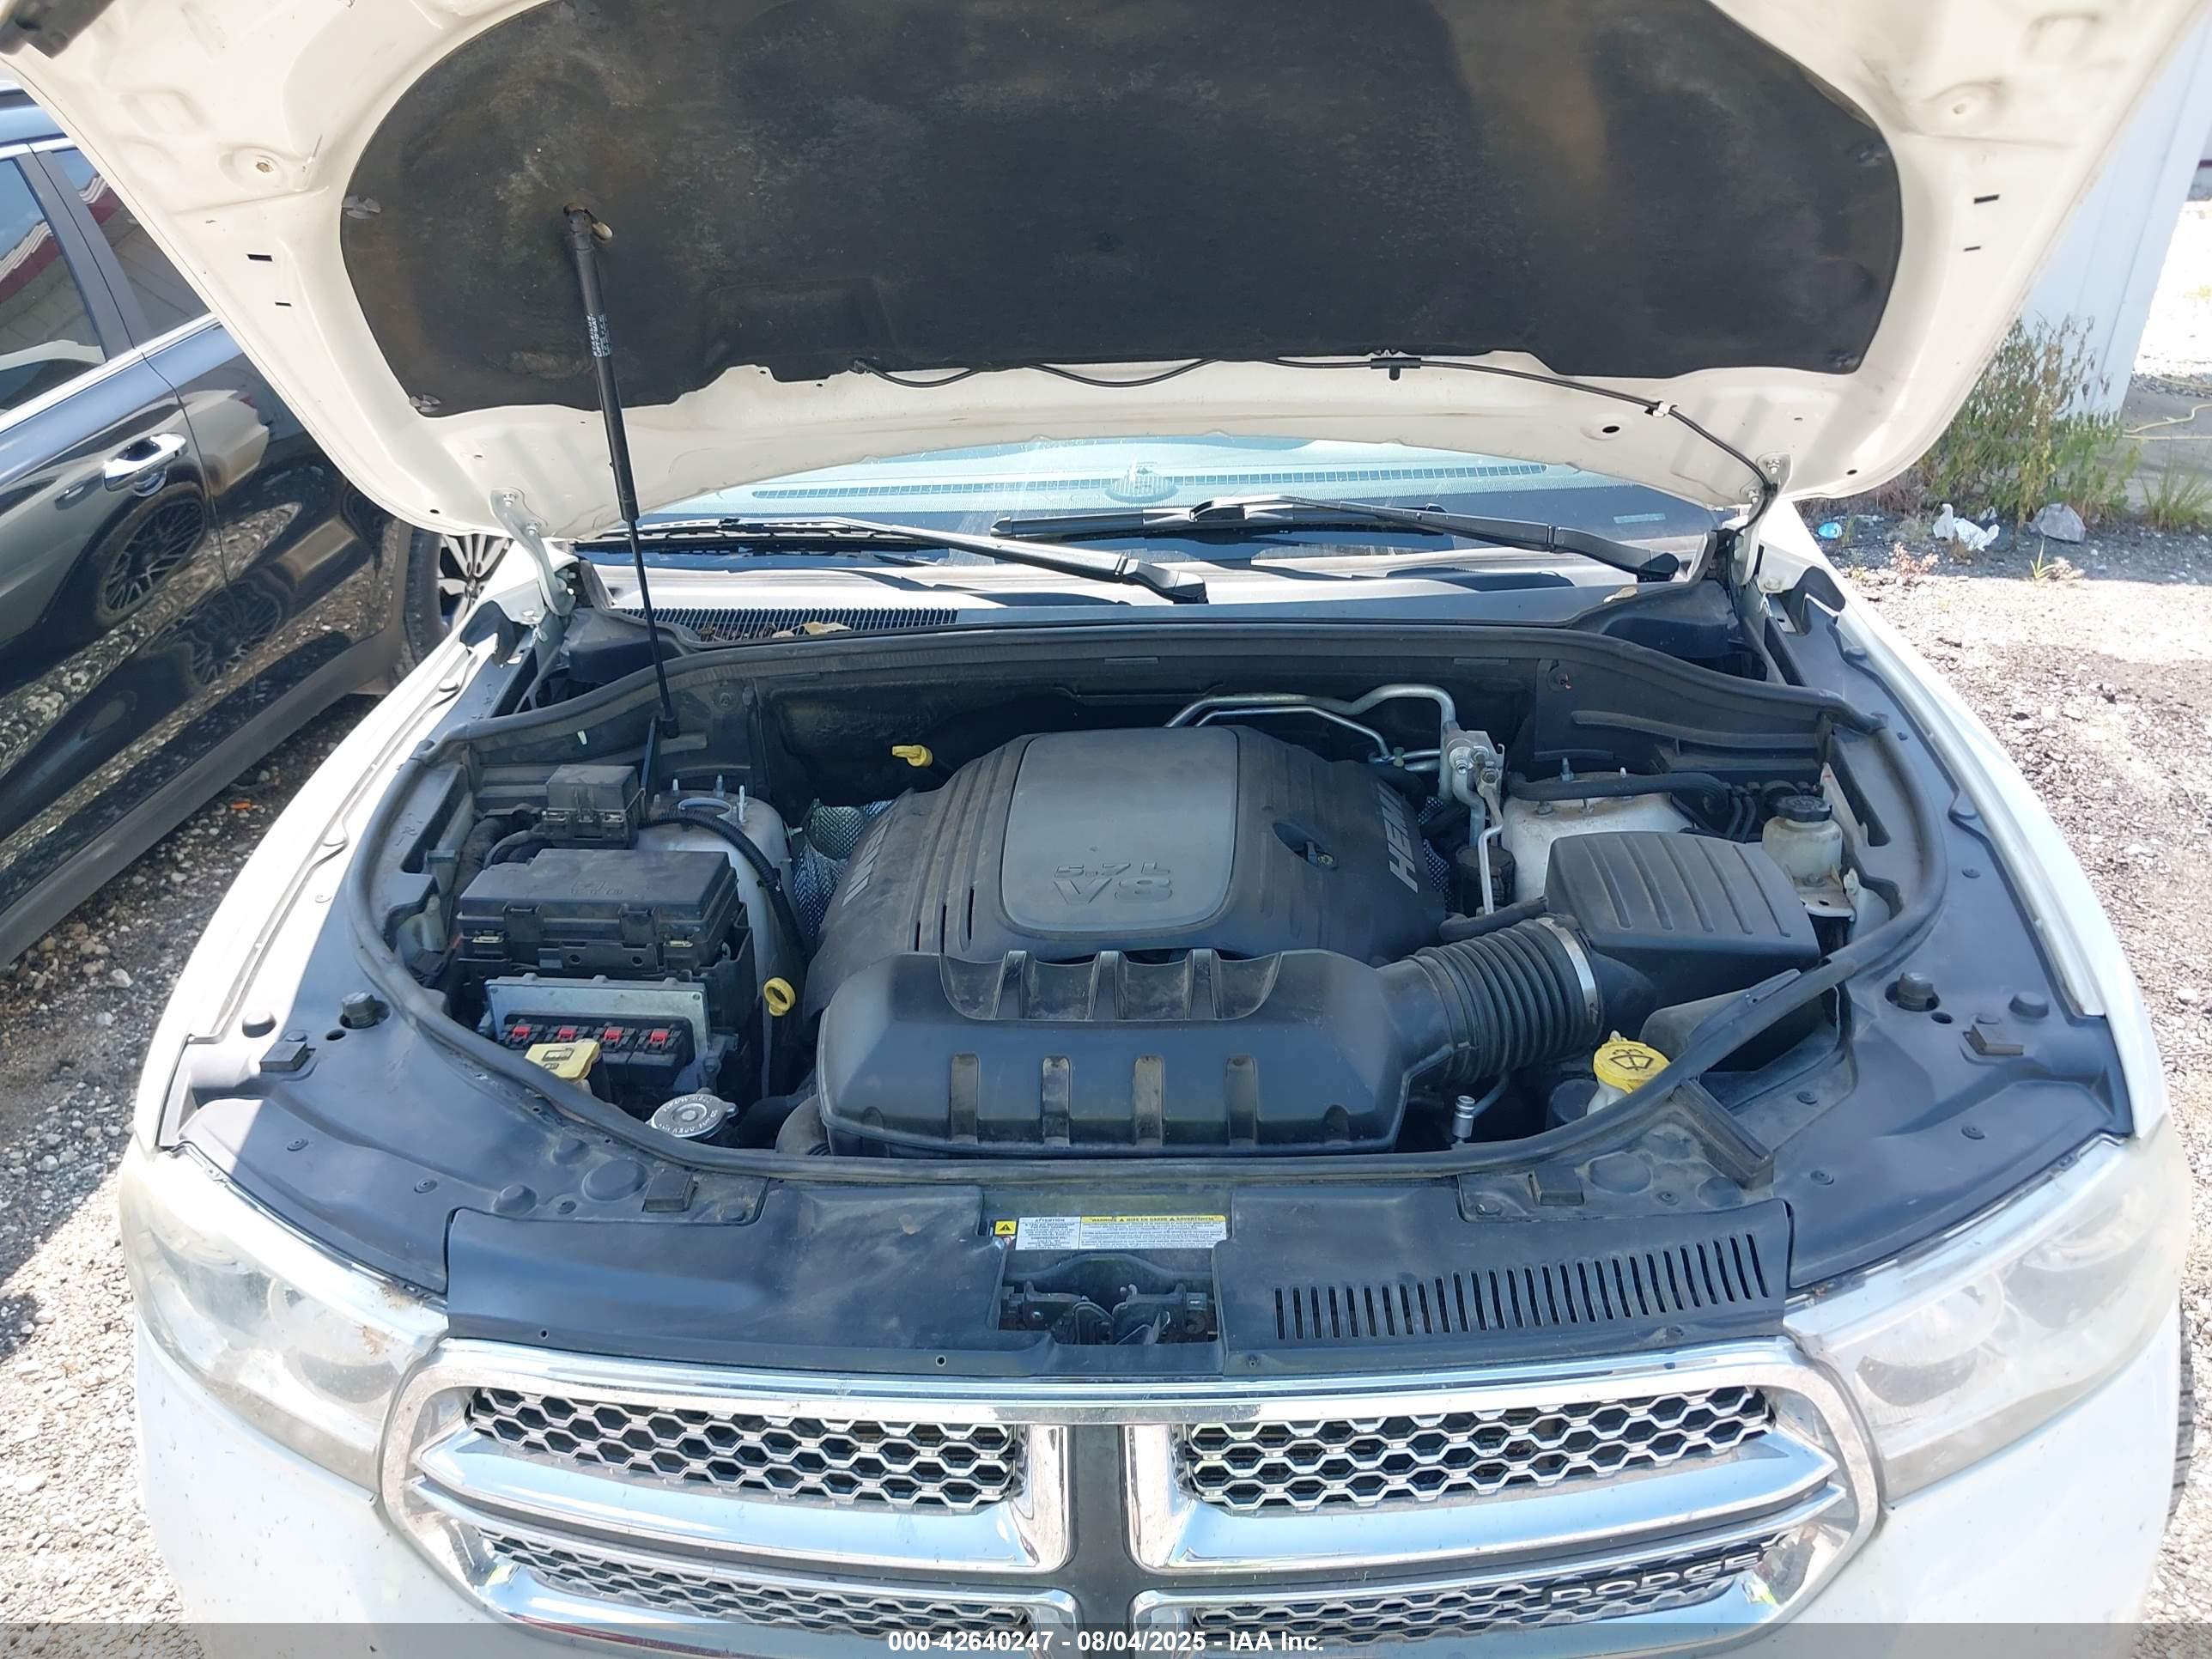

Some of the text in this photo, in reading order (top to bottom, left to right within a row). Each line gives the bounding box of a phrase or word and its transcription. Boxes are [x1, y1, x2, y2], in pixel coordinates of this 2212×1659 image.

[1376, 779, 1419, 894] HEMI
[1053, 876, 1173, 904] V8
[1551, 1552, 1760, 1603] DODGE
